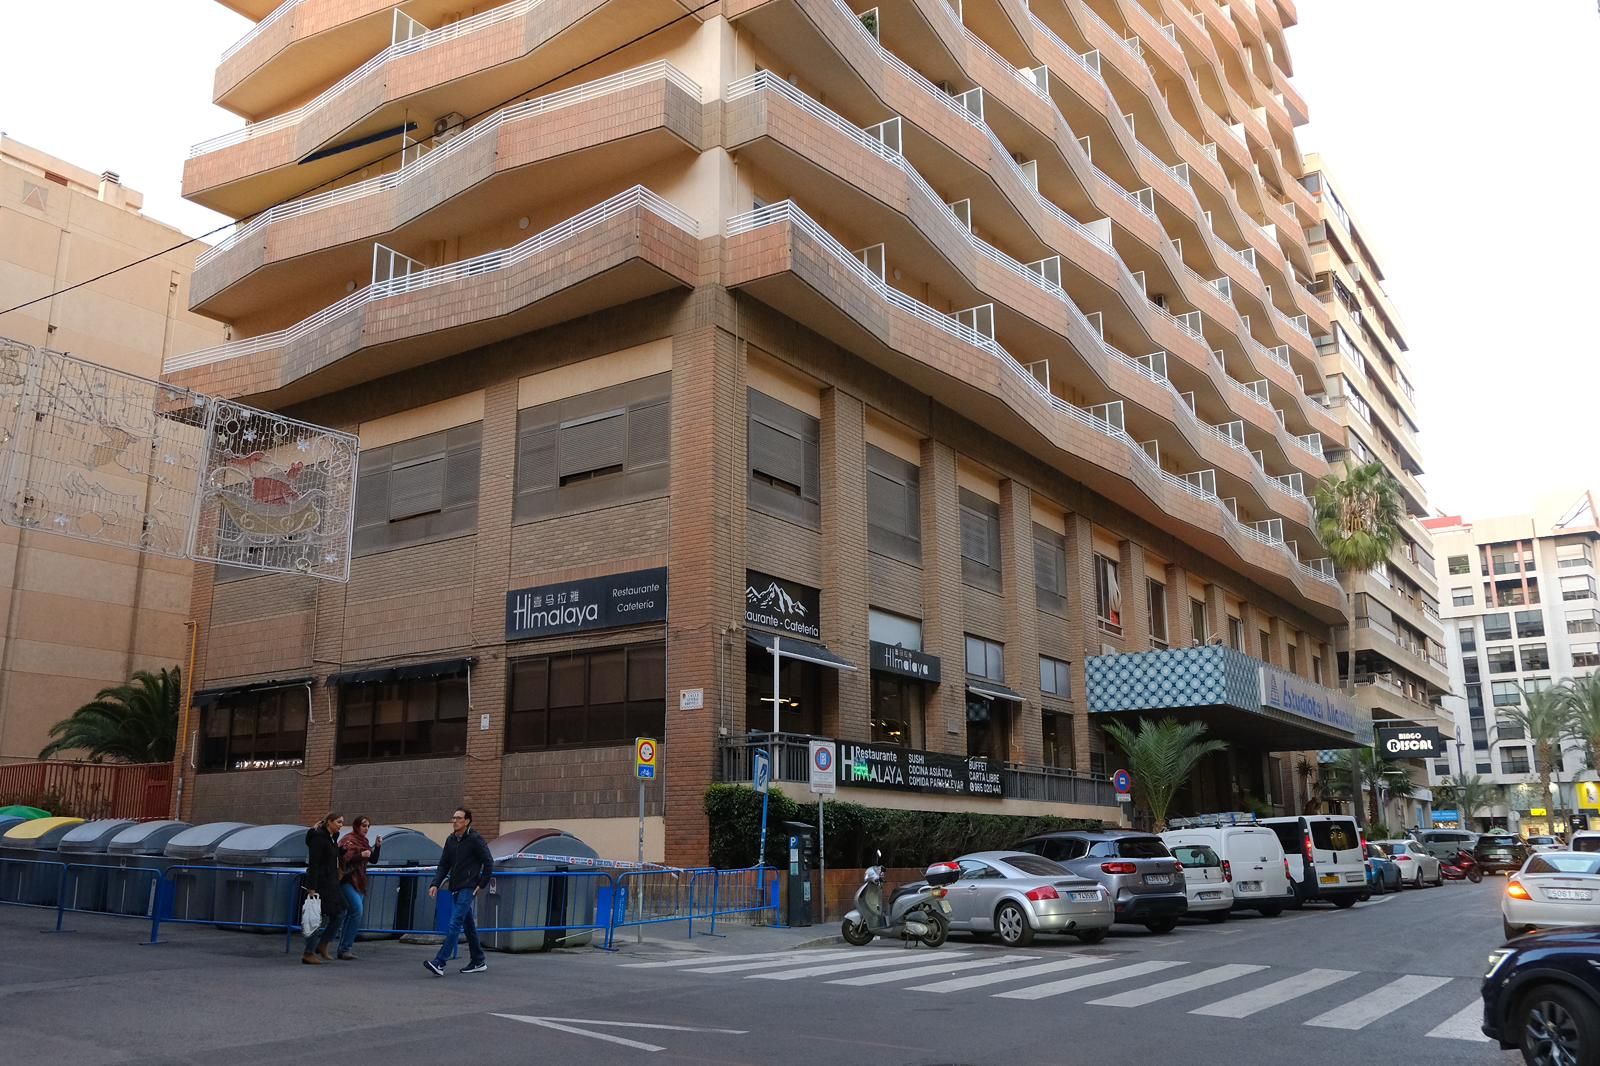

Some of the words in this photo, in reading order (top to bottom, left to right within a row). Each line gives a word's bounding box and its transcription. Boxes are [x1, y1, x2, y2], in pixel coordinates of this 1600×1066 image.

[612, 583, 660, 598] Restaurante
[513, 594, 598, 631] Himalaya
[784, 618, 819, 637] Cafetería
[1398, 732, 1422, 740] BINGO
[1386, 739, 1433, 753] RISCAL
[855, 746, 898, 763] Restaurante
[908, 753, 925, 764] SUSHI
[908, 765, 928, 776] COCINA
[929, 766, 953, 778] ASIÁTICA
[968, 760, 987, 771] BUFFET
[908, 776, 929, 787] COMIDA
[929, 777, 944, 788] PARA
[968, 771, 986, 782] CARTA
[986, 773, 1000, 784] LIBRE
